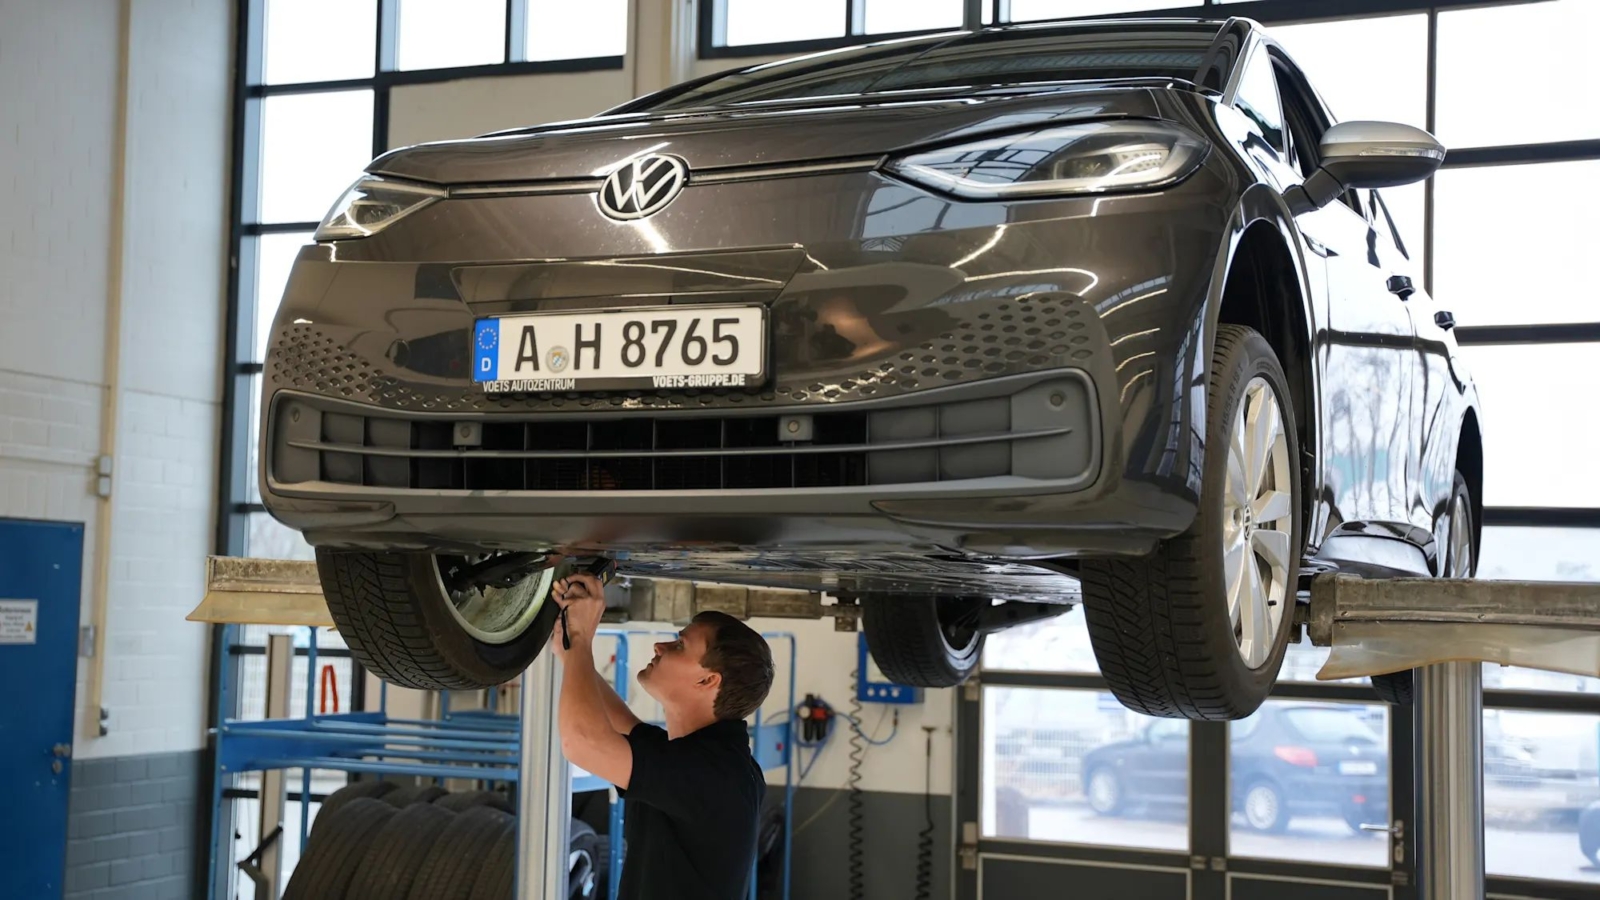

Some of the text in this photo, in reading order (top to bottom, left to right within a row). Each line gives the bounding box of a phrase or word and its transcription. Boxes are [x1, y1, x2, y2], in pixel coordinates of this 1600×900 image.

[600, 154, 683, 217] VW
[514, 318, 740, 372] A H 8765
[481, 357, 491, 372] D
[483, 378, 576, 393] VOETS AUTOZENTRUM
[652, 374, 745, 388] VOETS-GRUPPE.DE
